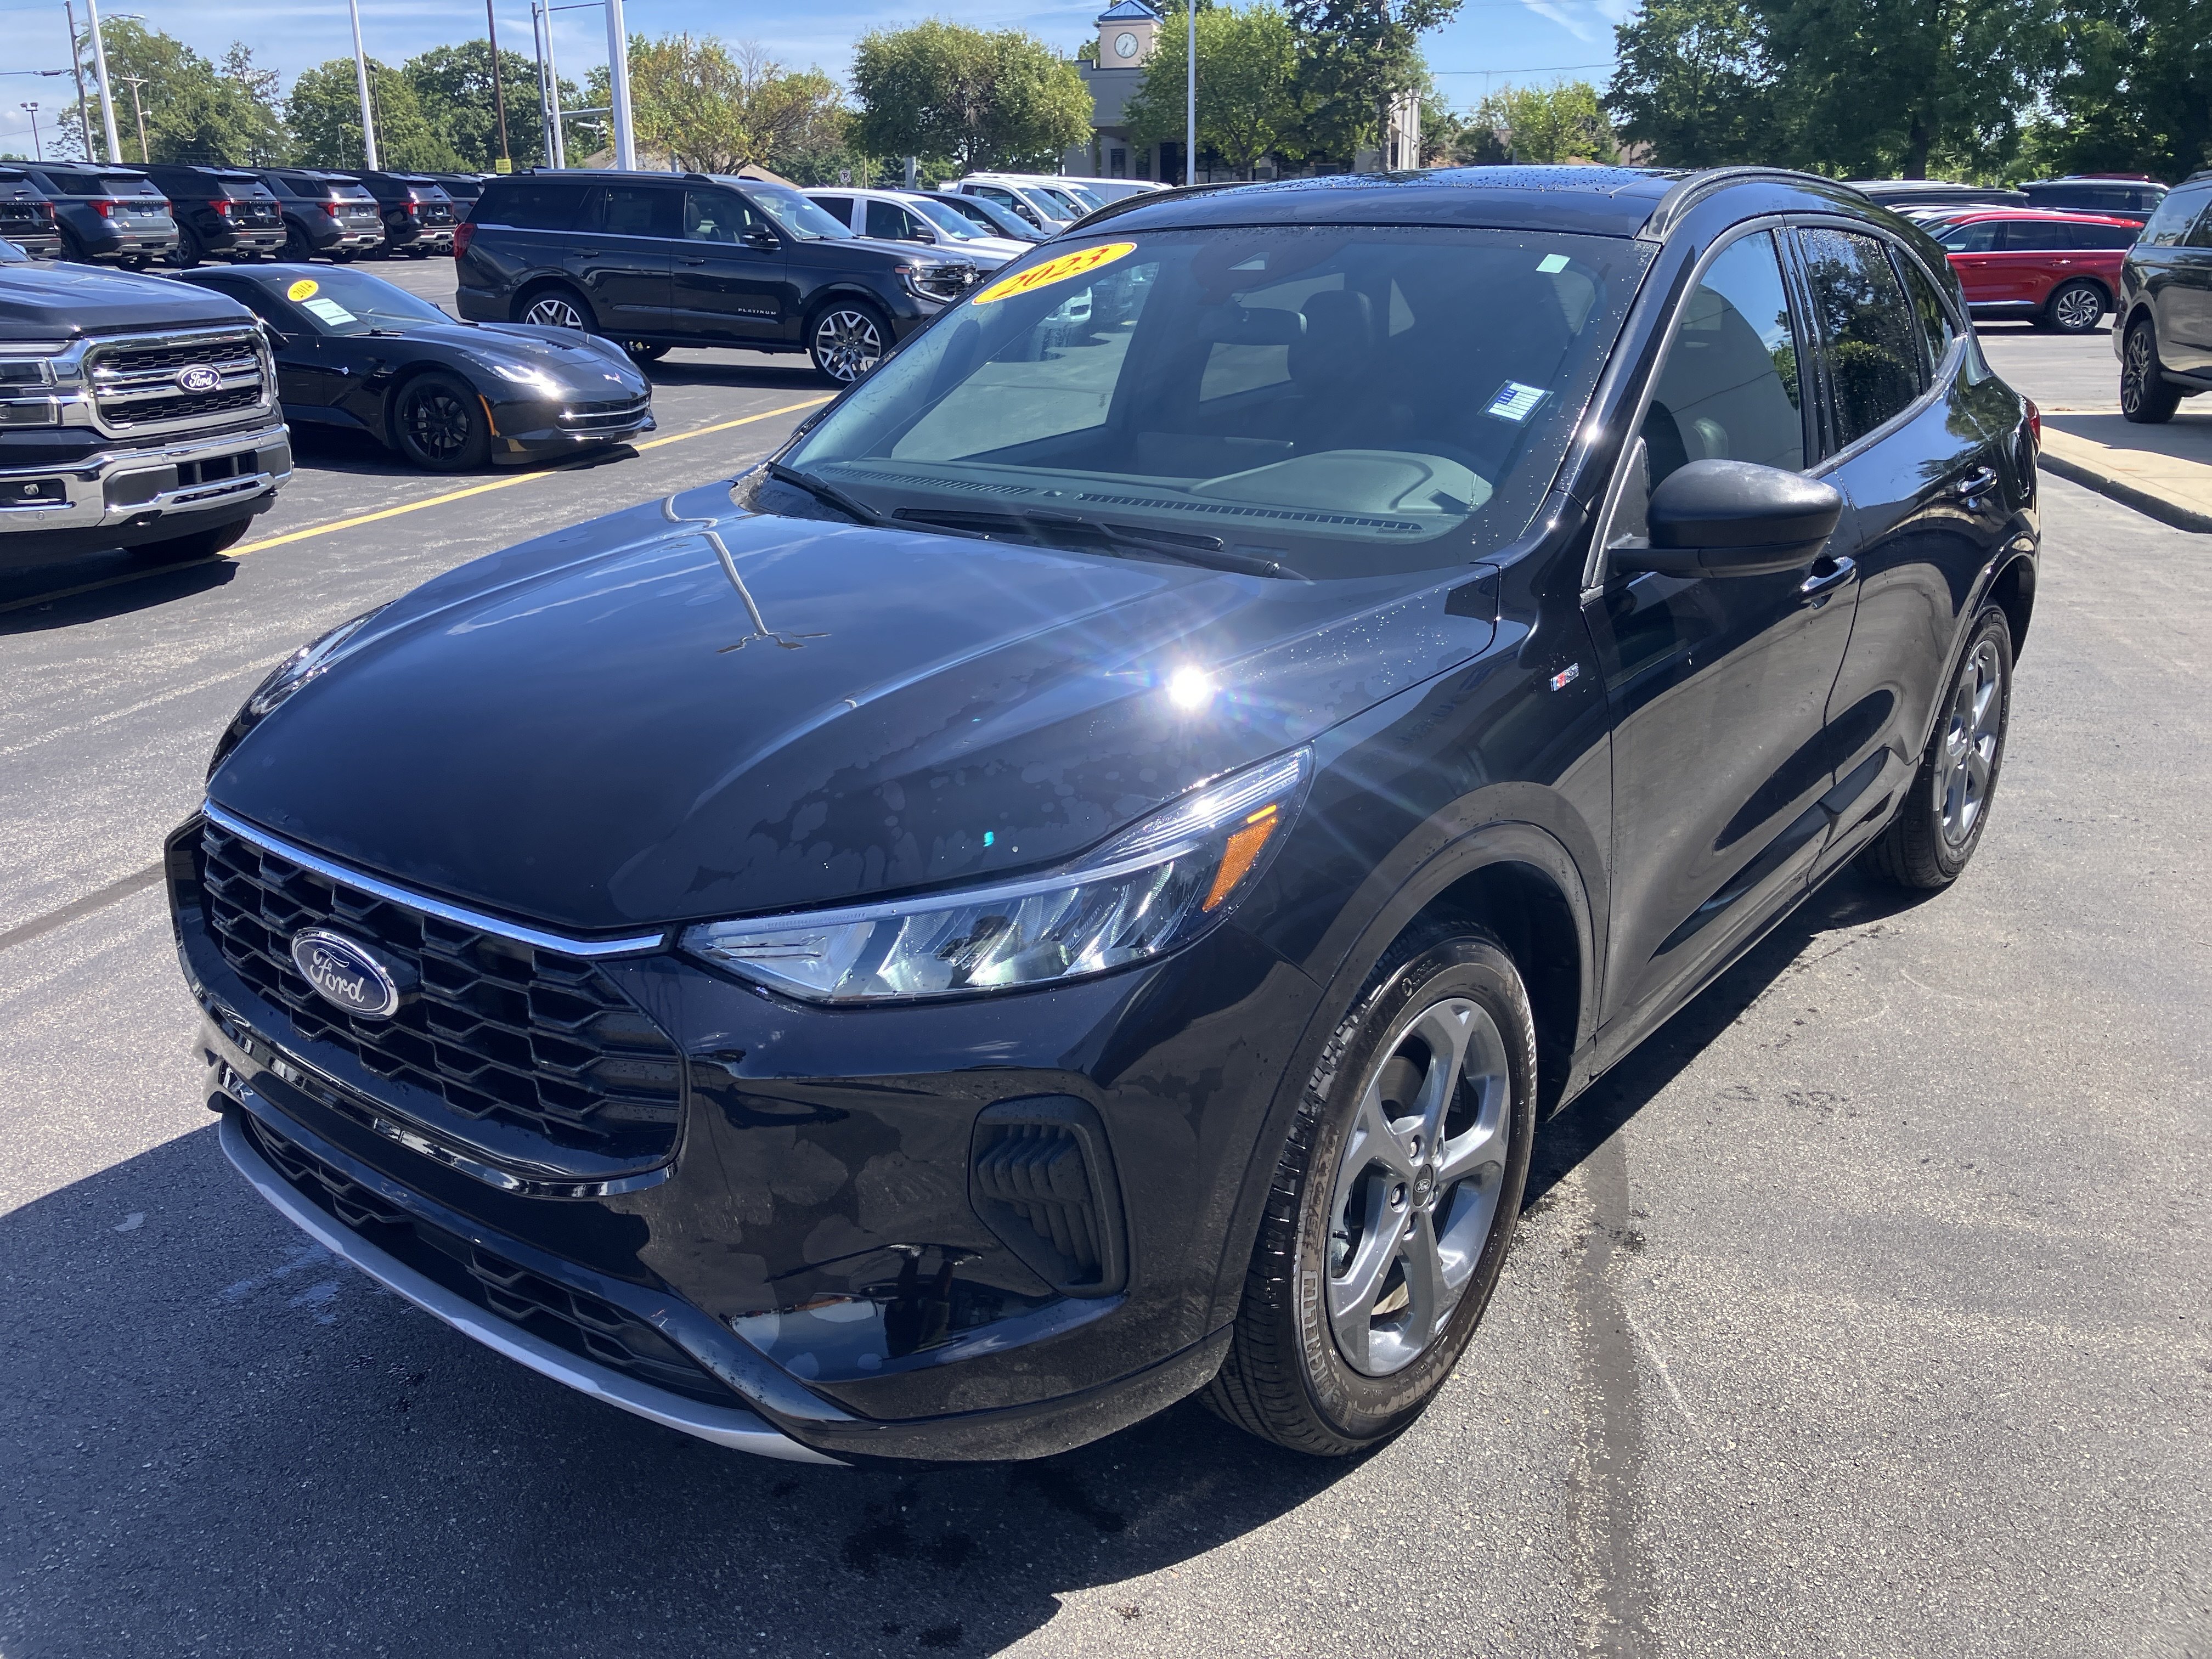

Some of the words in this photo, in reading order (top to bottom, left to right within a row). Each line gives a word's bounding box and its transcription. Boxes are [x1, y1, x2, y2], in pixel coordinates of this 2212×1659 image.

[293, 281, 313, 298] 2014
[992, 248, 1109, 298] 2023
[189, 371, 213, 387] Ford
[309, 947, 365, 1003] Ford
[1417, 1181, 1429, 1191] Ford
[1303, 1277, 1335, 1398] MICHELIN
